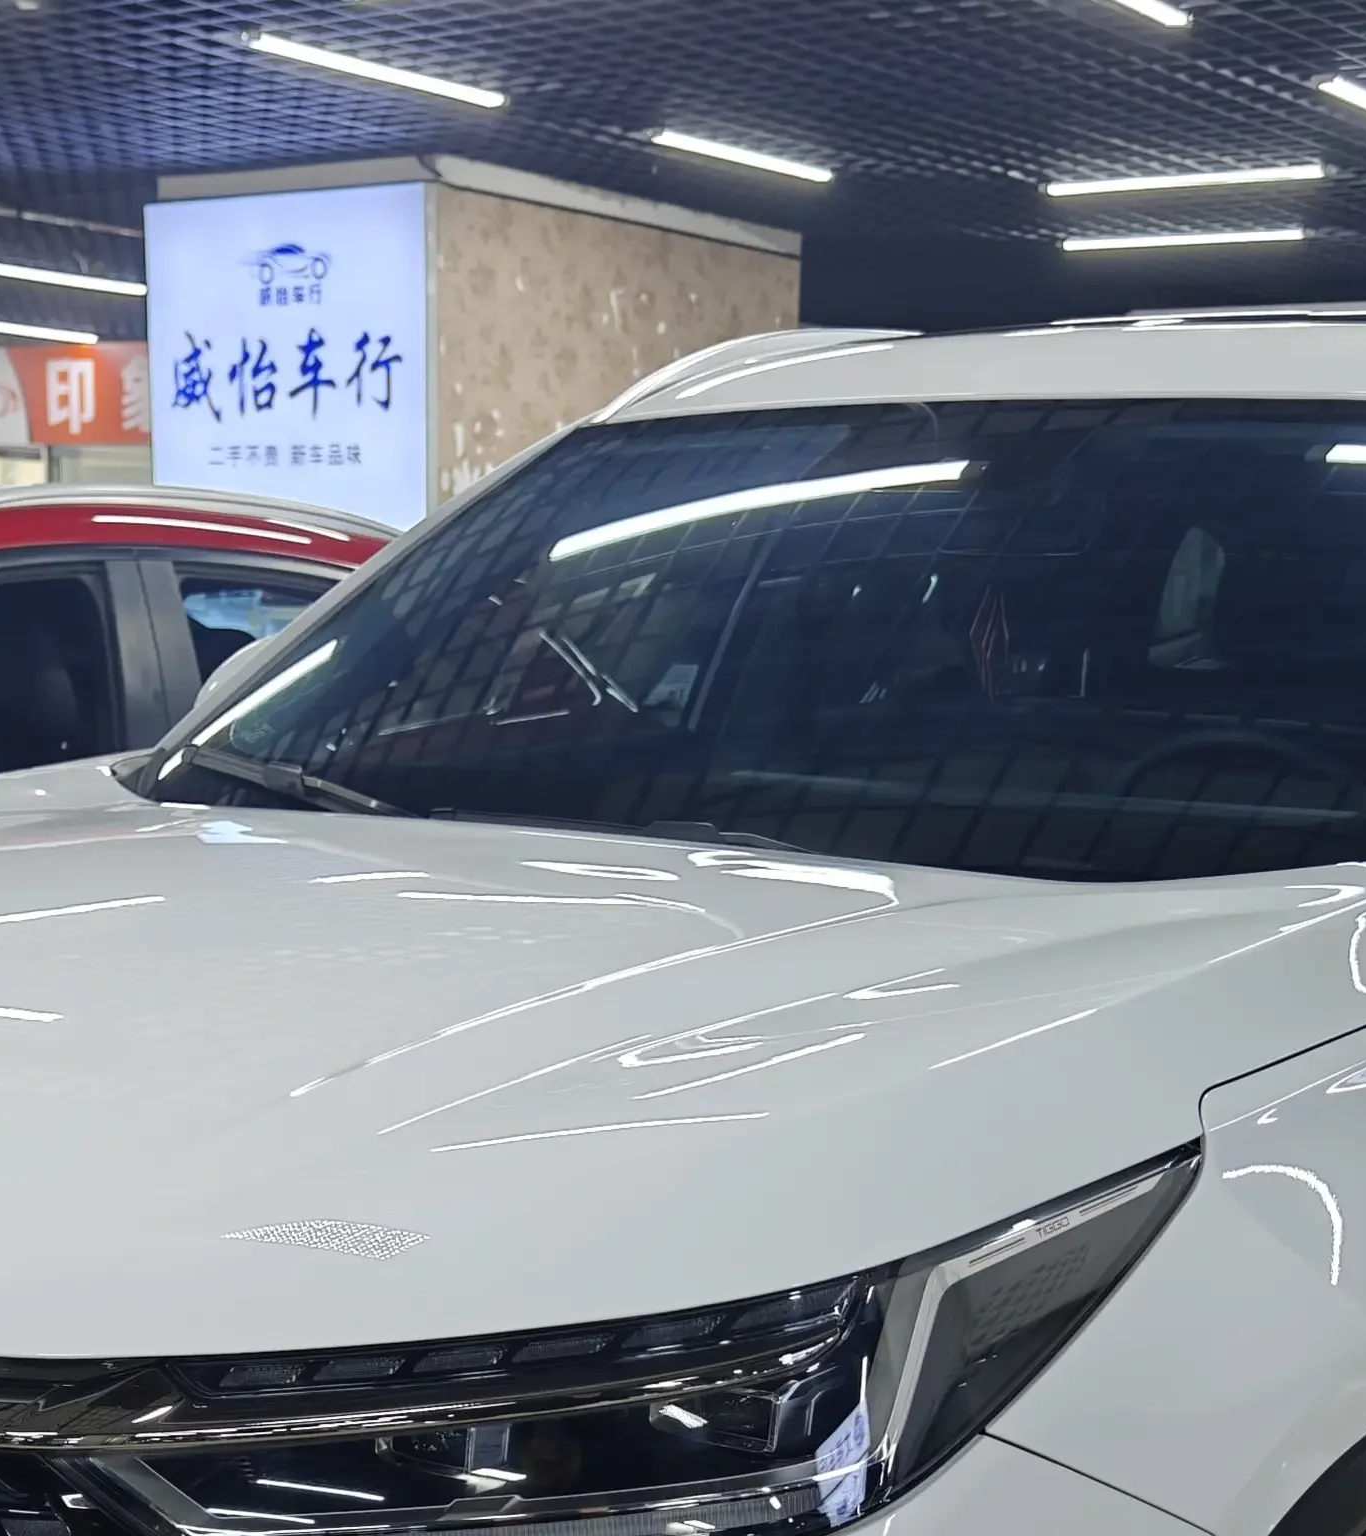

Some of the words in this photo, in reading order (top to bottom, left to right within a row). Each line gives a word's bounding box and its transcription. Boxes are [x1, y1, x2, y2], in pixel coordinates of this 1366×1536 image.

[172, 328, 403, 422] 威怡车行
[1035, 1216, 1070, 1239] TIGGO
